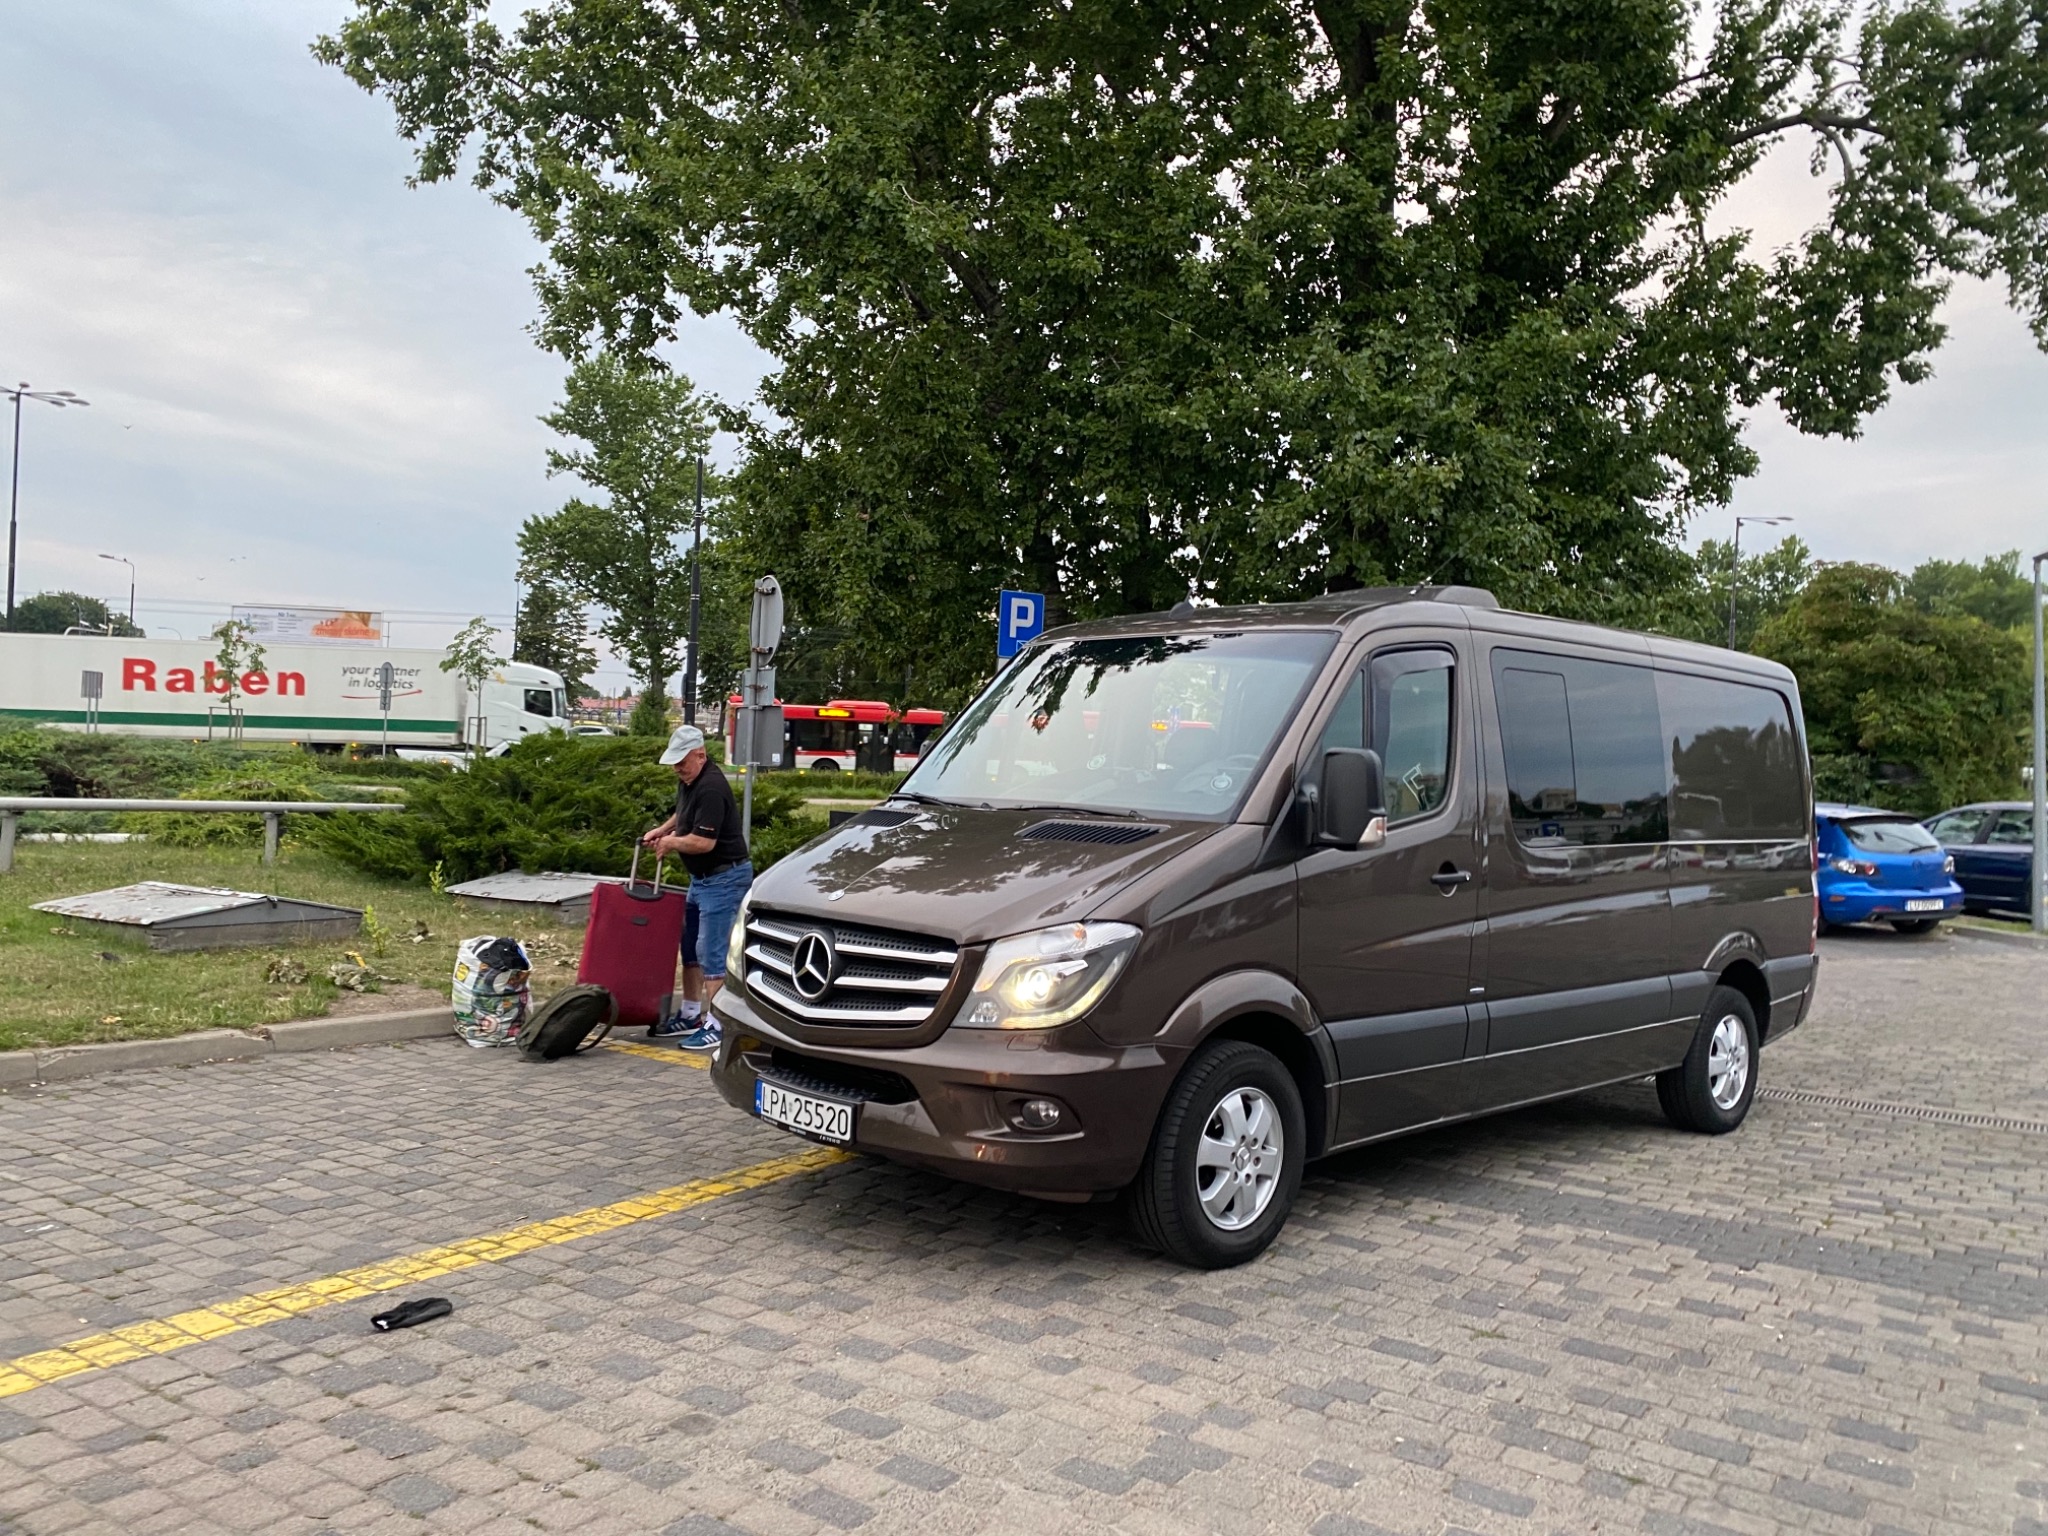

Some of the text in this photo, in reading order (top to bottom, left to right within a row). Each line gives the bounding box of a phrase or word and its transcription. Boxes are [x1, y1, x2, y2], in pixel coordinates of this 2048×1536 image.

[1009, 597, 1035, 638] P
[122, 657, 306, 697] Raben
[341, 666, 421, 678] your ptner
[348, 677, 414, 691] in logtics
[762, 1086, 849, 1136] LPA 25520
